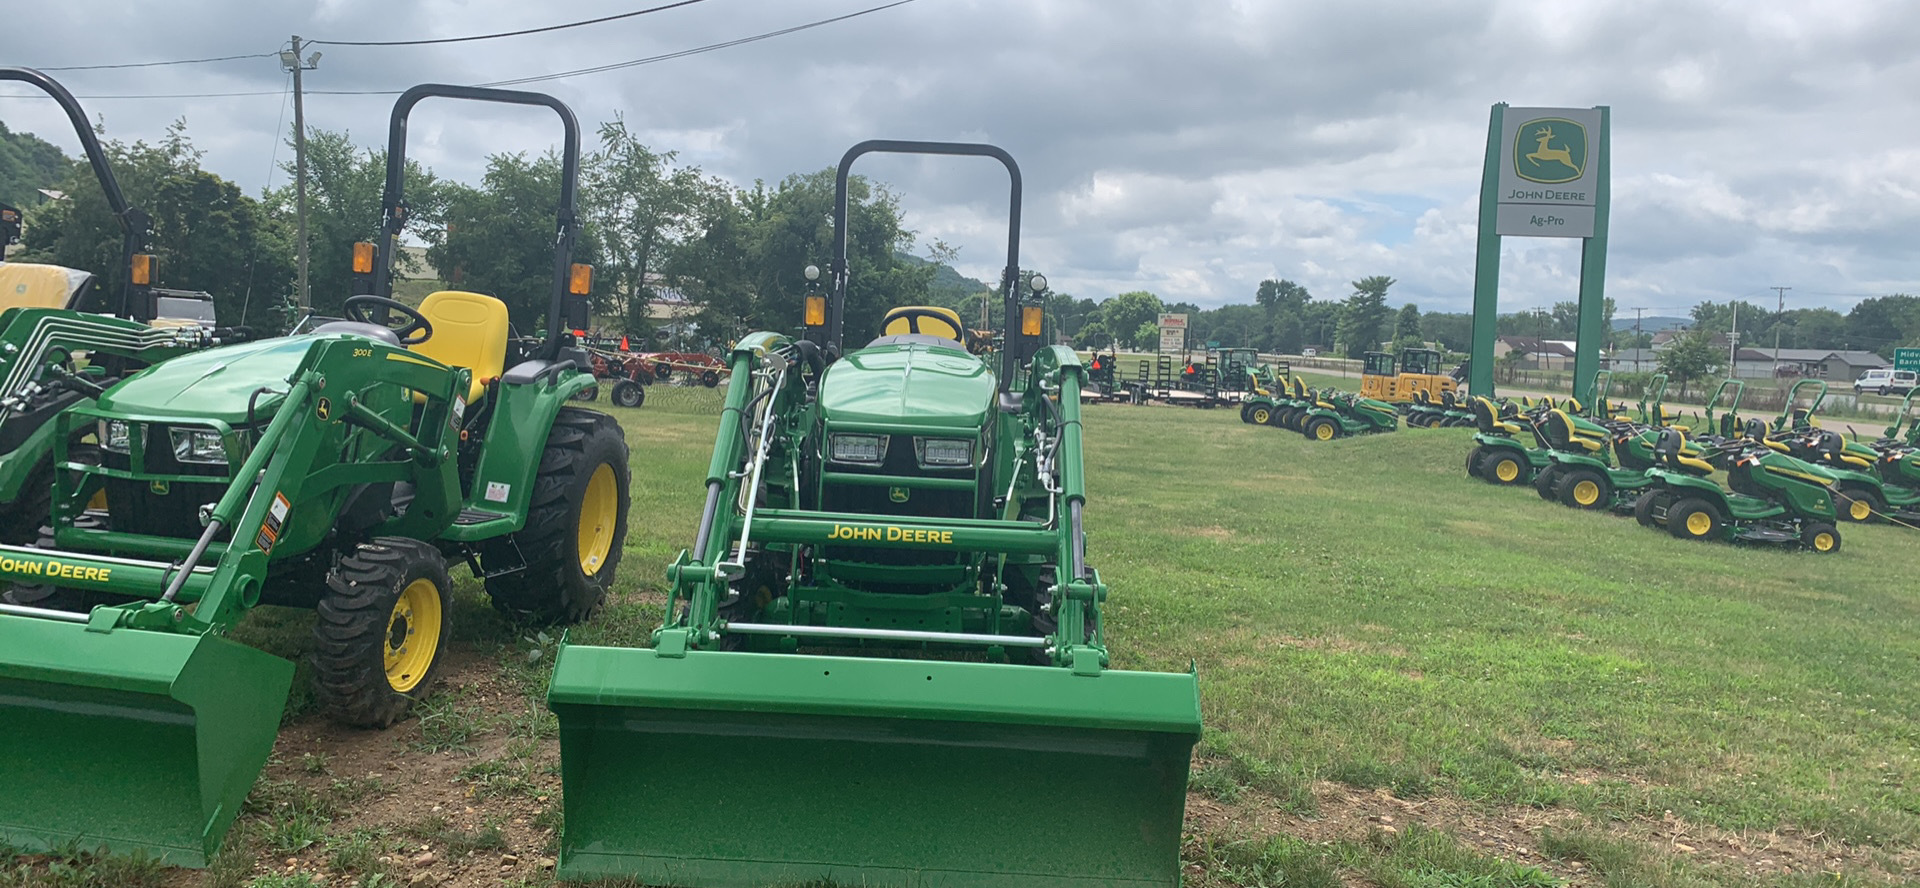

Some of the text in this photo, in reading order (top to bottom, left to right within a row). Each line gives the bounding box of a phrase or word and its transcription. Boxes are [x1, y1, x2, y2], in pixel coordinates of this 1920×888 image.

[1508, 190, 1585, 200] JOHN DEERE
[1530, 215, 1564, 226] Ag-Pro
[828, 524, 953, 543] JOHN DEERE
[46, 561, 111, 581] DEERE
